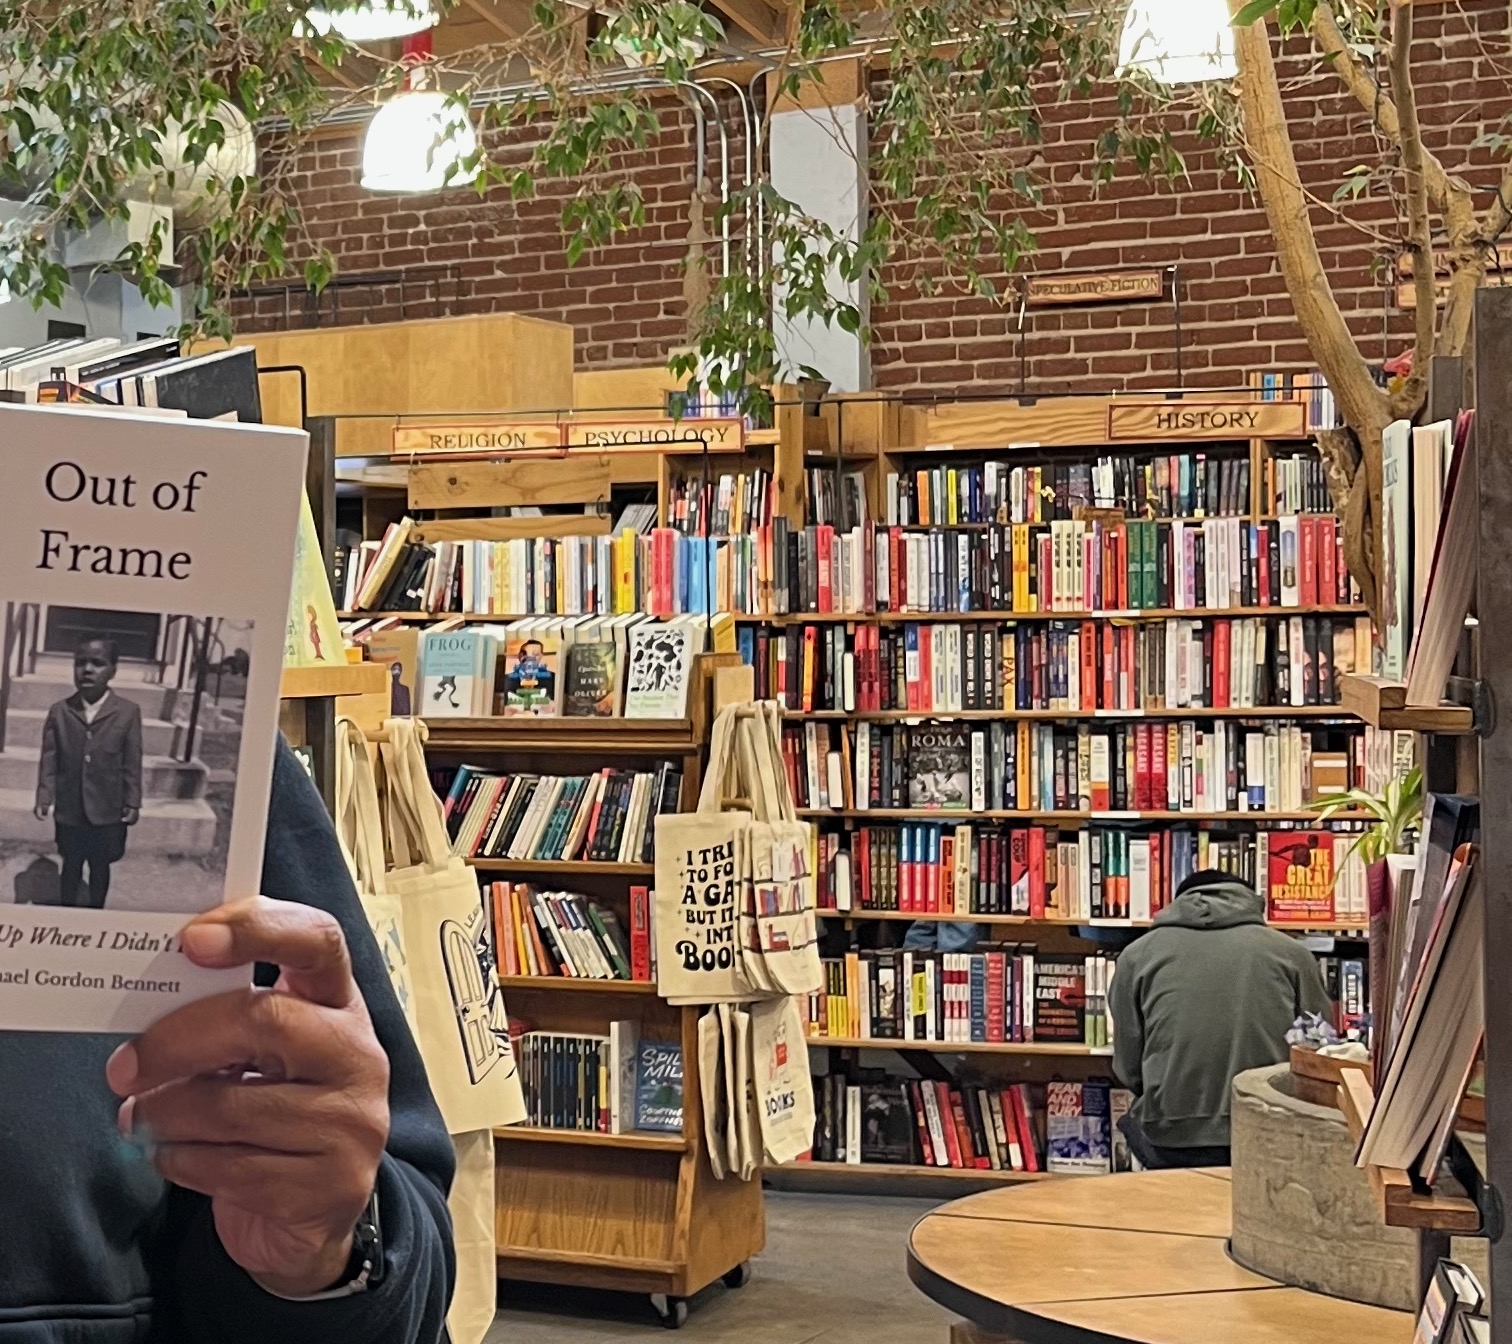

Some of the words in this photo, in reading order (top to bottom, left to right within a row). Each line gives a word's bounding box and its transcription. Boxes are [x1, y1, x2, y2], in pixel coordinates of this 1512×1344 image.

[1156, 411, 1260, 431] HISTORY
[429, 432, 527, 450] RELIGION
[584, 425, 730, 448] PSYCHOLOGY
[44, 461, 137, 509] Out
[152, 469, 208, 514] of
[36, 529, 194, 583] Frame
[428, 637, 472, 652] FROG
[1003, 656, 1015, 686] PAX
[911, 733, 967, 749] ROMA
[687, 850, 693, 866] I
[1310, 848, 1332, 866] THE
[687, 867, 707, 884] TO
[1287, 865, 1332, 885] GREAT
[682, 885, 697, 905] A
[686, 908, 717, 925] BUT
[29, 926, 92, 948] Where
[96, 930, 108, 949] I
[110, 931, 175, 953] Didn't
[675, 940, 735, 972] BOO
[34, 970, 105, 989] Gordon
[111, 974, 181, 994] Bennett
[1036, 988, 1063, 1000] EAST
[641, 1047, 683, 1068] SPIL
[1048, 1082, 1083, 1094] FEAR
[1048, 1094, 1078, 1106] AND
[1048, 1105, 1083, 1118] FURY
